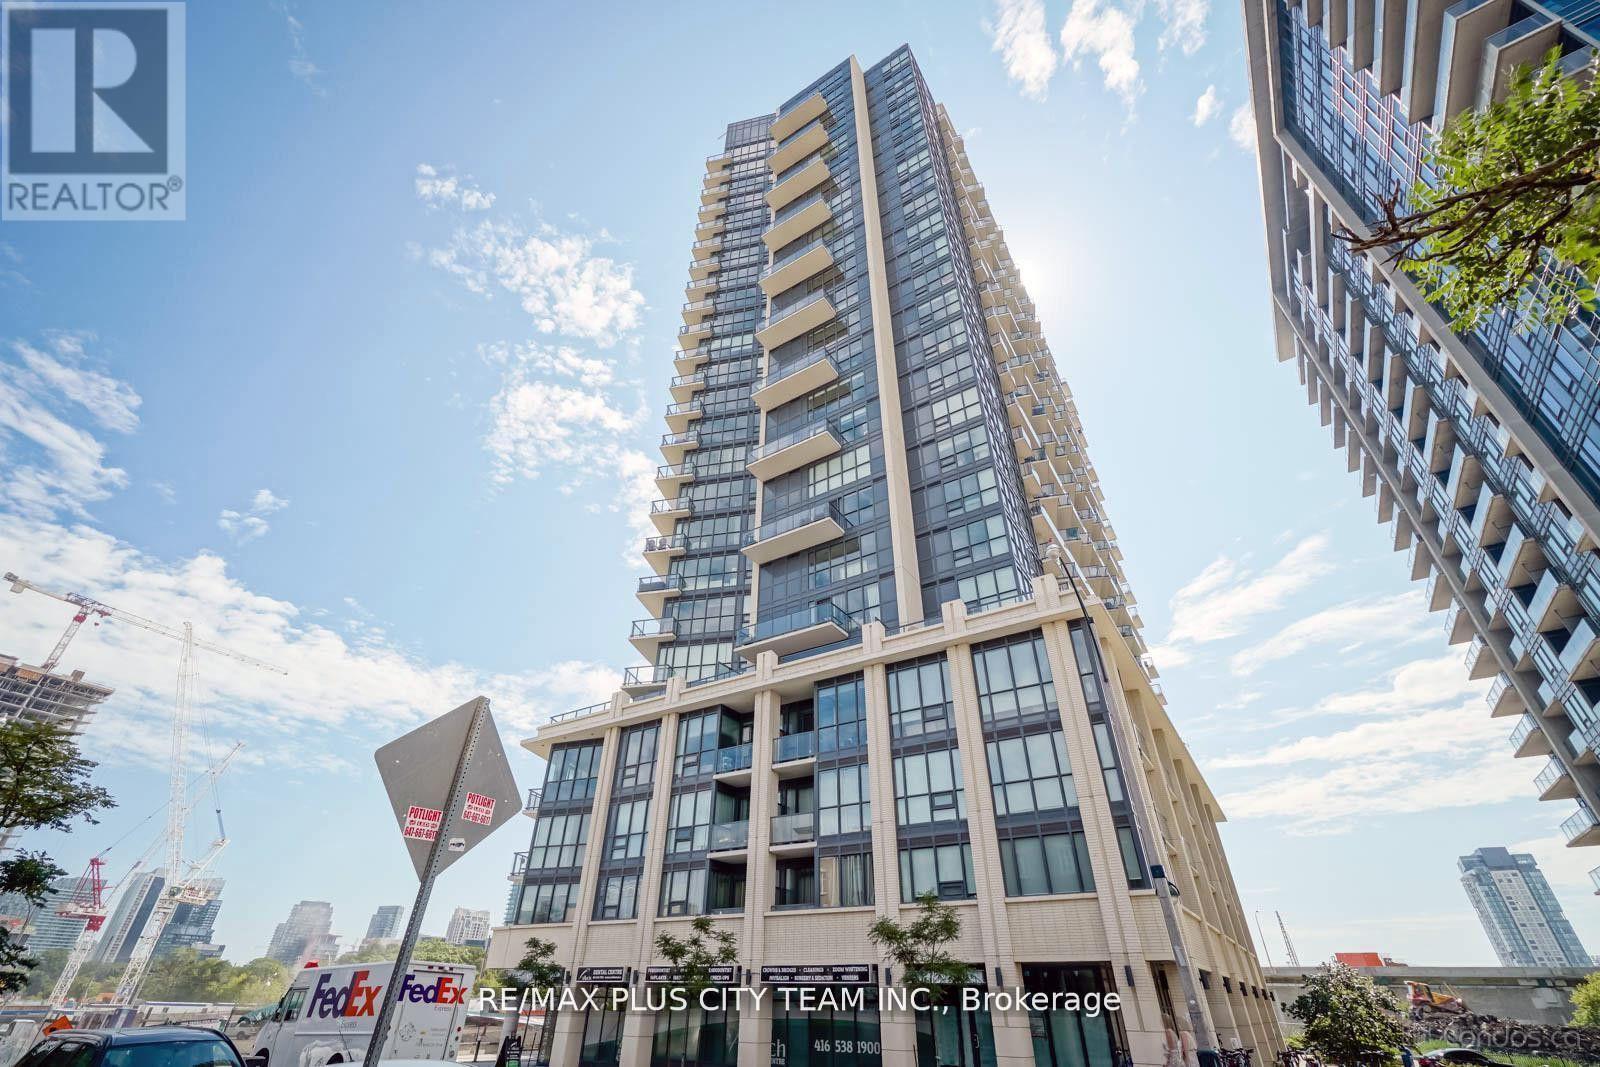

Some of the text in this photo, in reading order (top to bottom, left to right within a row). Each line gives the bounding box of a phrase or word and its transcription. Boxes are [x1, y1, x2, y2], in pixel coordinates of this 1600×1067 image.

[466, 792, 495, 810] POTLIGHT
[408, 806, 443, 823] POTLIGHT
[307, 970, 383, 1019] FedEx
[397, 974, 468, 1005] FedEx
[814, 1039, 881, 1055] 416 538 1900
